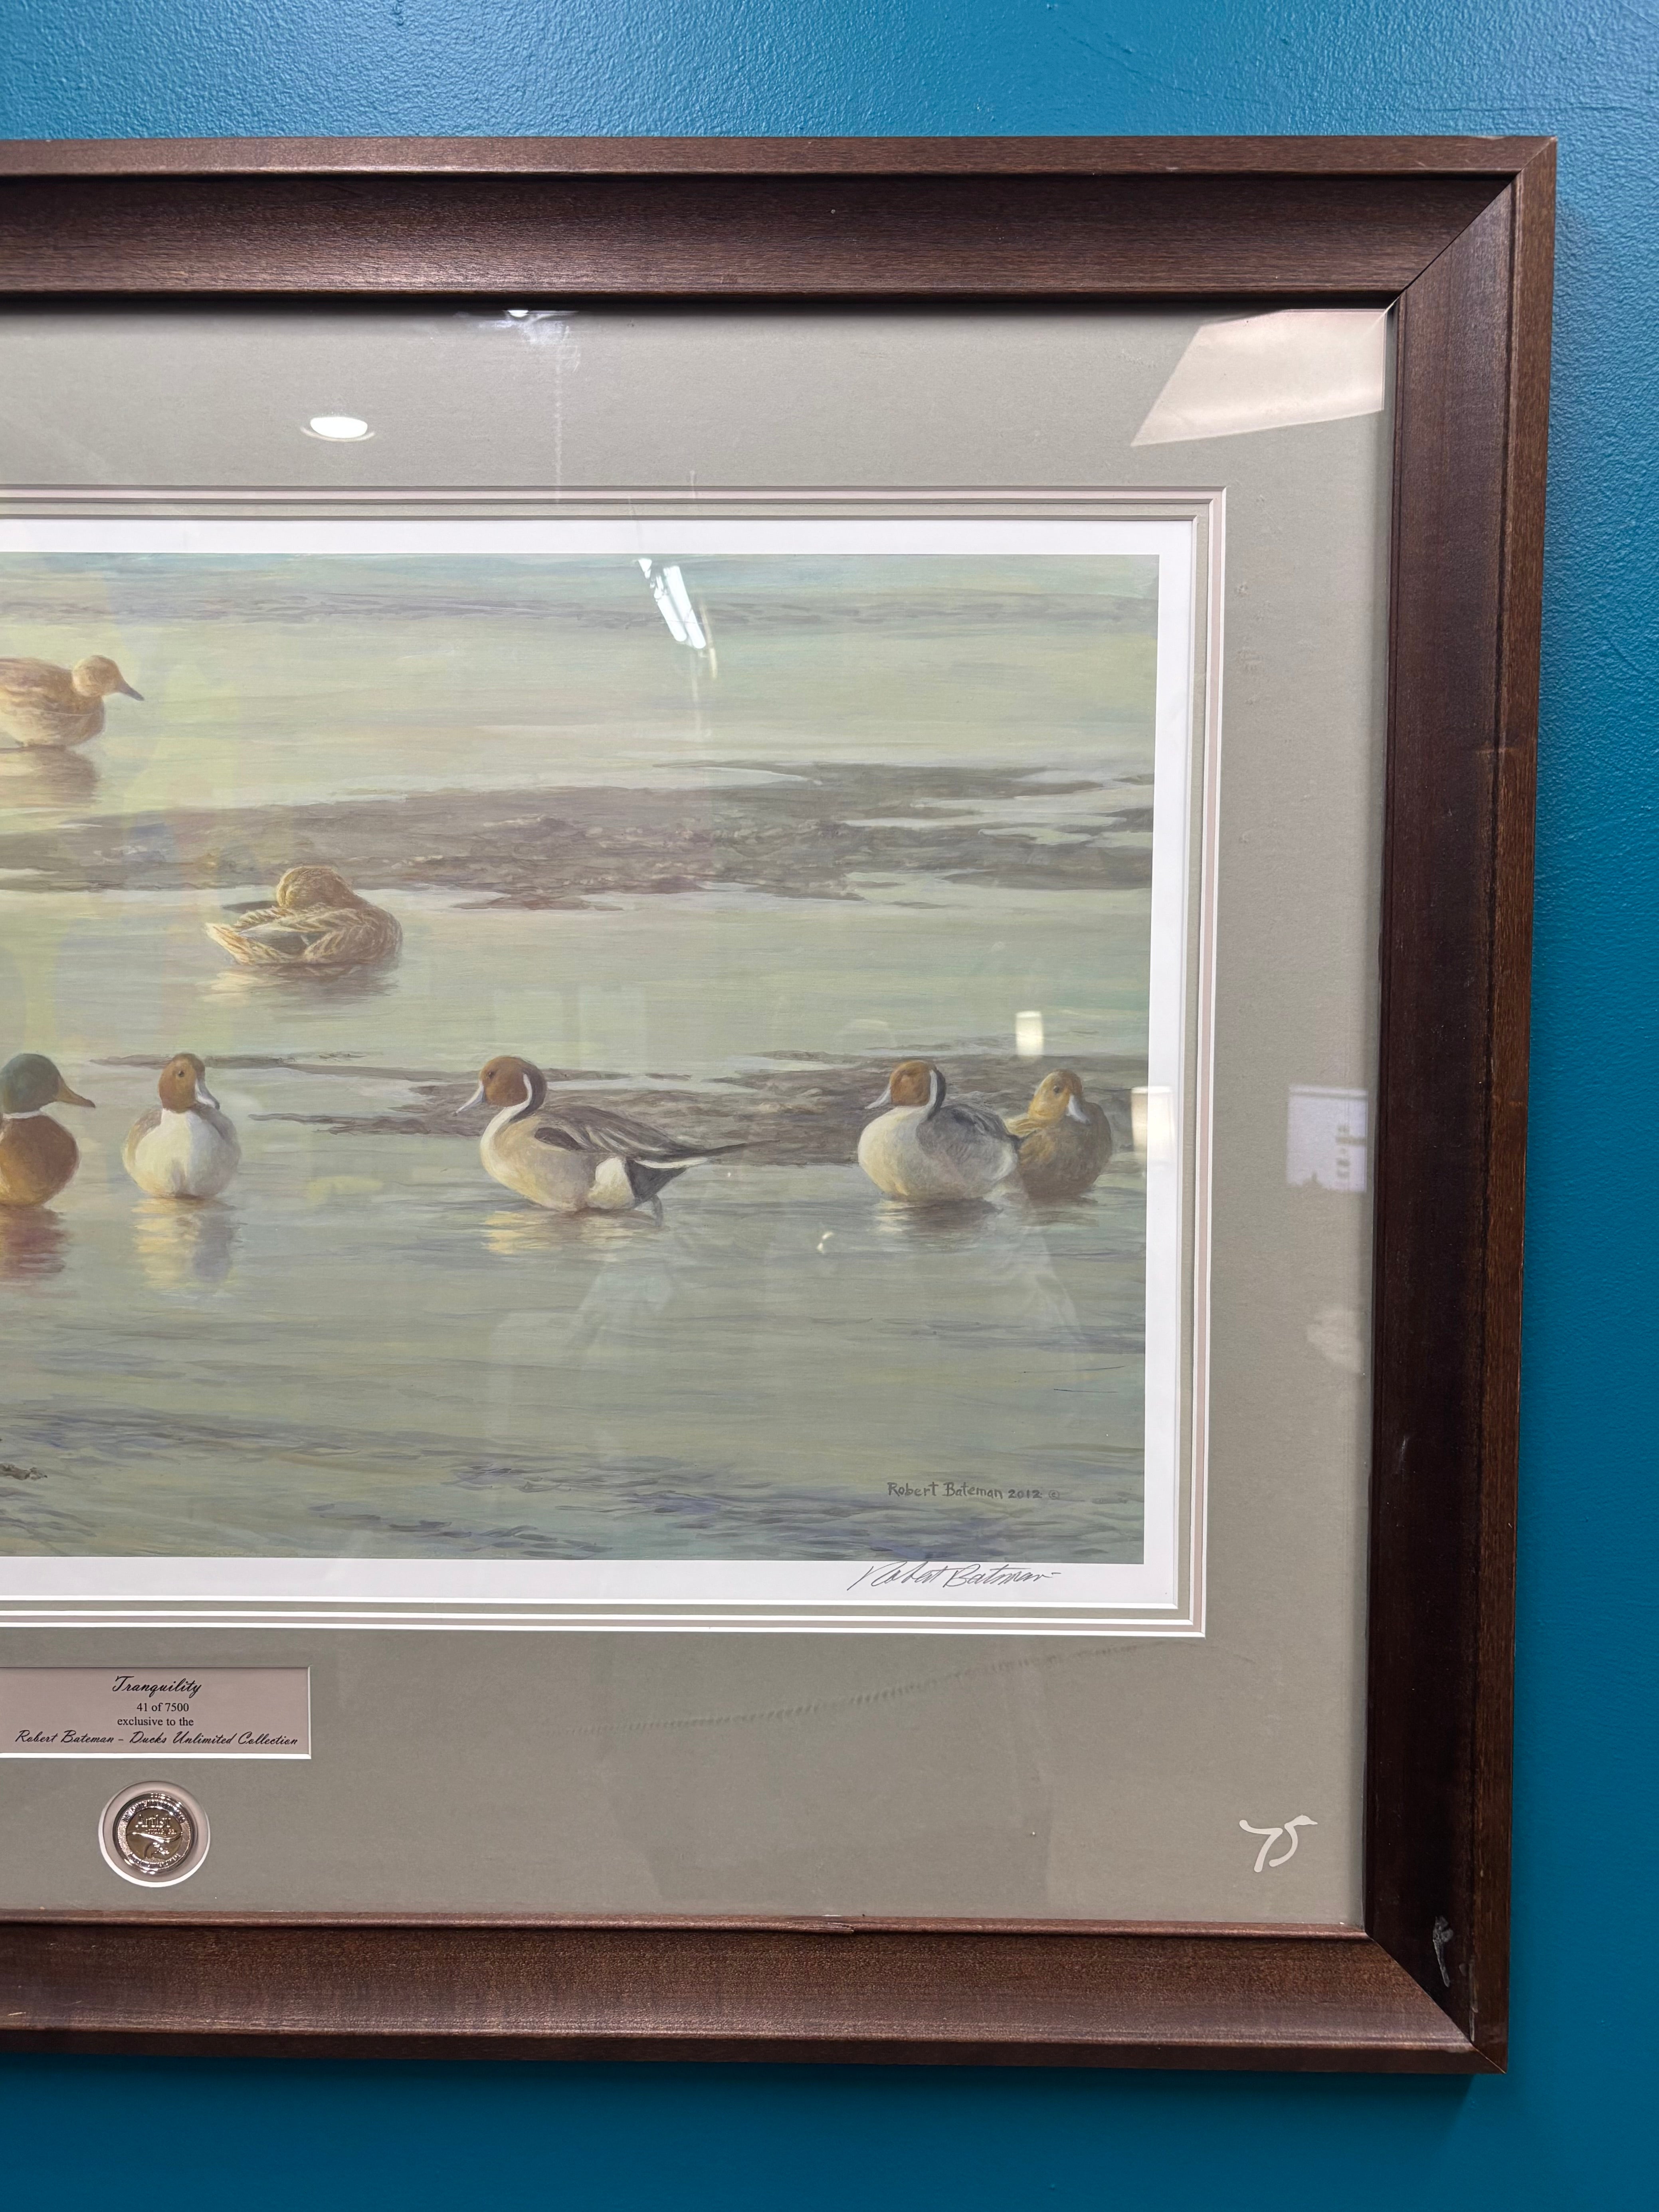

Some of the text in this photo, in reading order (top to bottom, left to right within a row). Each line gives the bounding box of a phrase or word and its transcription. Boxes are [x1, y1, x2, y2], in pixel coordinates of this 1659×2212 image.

[887, 1481, 939, 1497] Robert
[942, 1482, 1003, 1499] Bateman
[1008, 1488, 1042, 1499] 2012
[113, 1676, 202, 1698] Tranquility
[137, 1703, 189, 1711] 41 of 7500
[117, 1717, 163, 1725] exclusive
[179, 1717, 194, 1726] the
[15, 1730, 58, 1742] Robert
[61, 1730, 114, 1743] Bateman
[129, 1731, 166, 1743] Ducks
[173, 1731, 237, 1744] Unlimited
[236, 1731, 297, 1744] Collection
